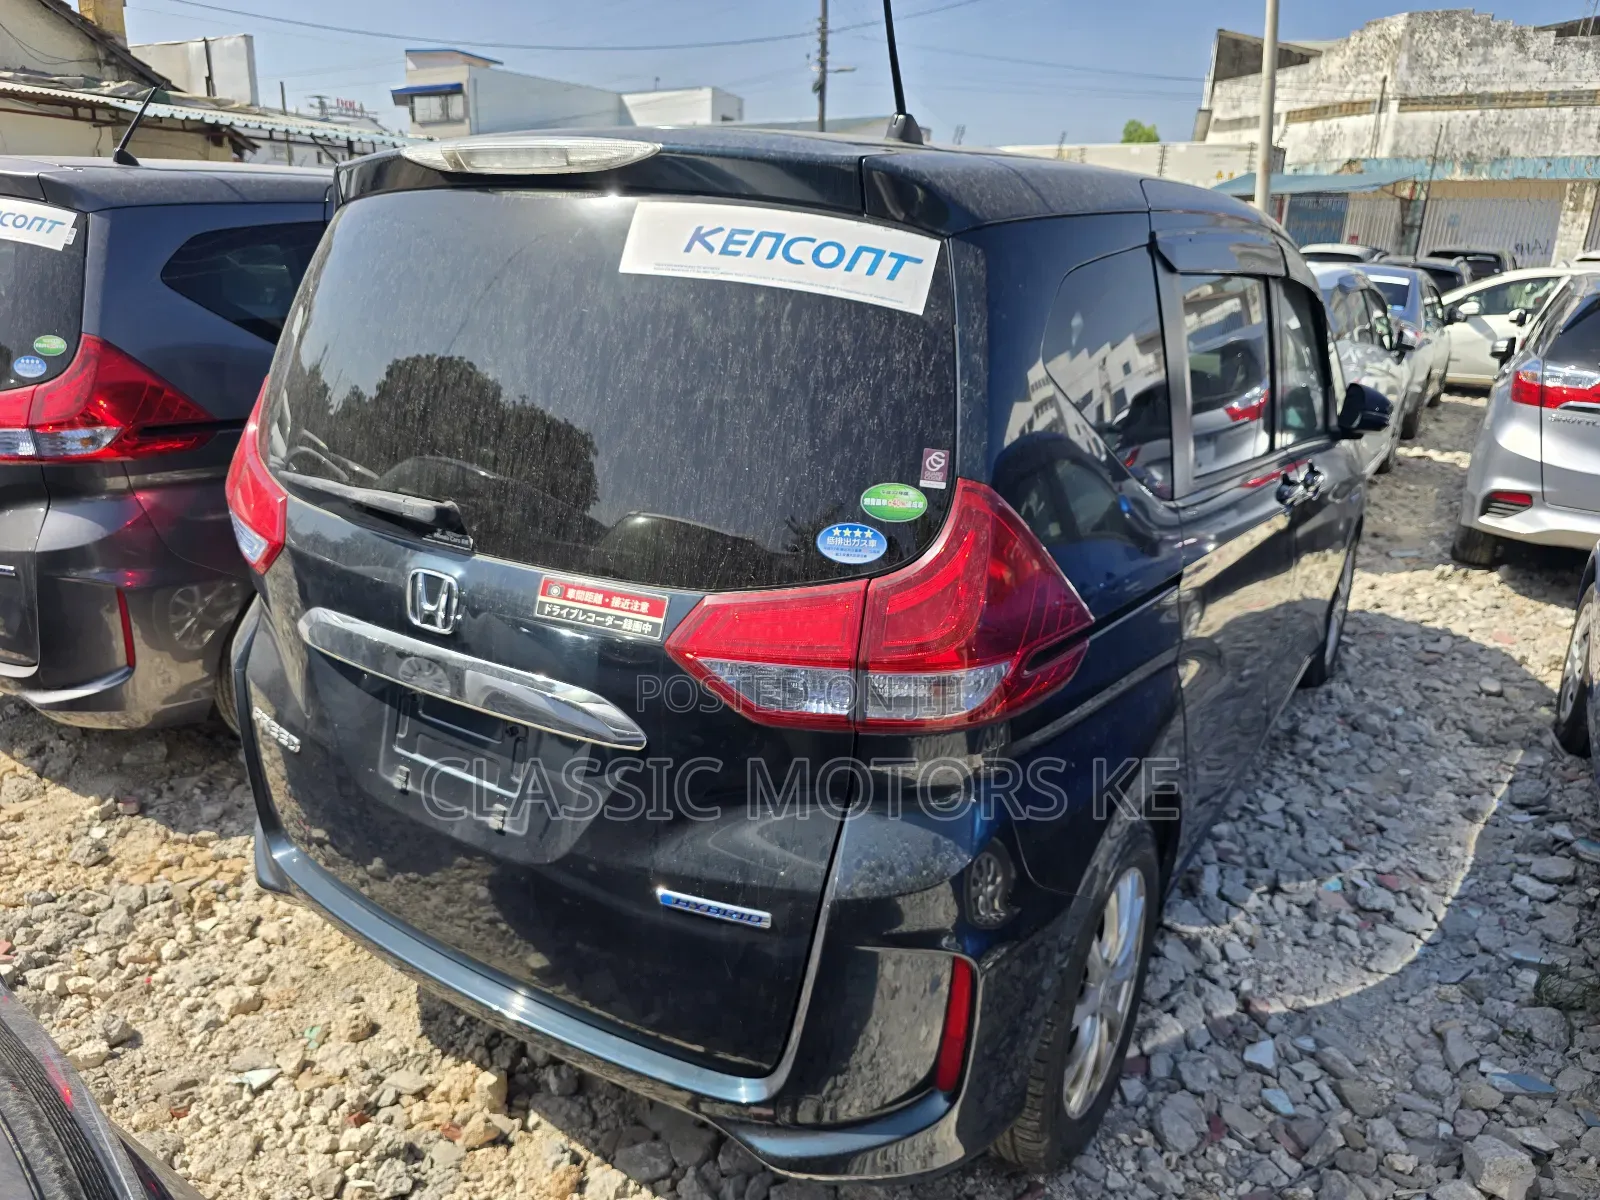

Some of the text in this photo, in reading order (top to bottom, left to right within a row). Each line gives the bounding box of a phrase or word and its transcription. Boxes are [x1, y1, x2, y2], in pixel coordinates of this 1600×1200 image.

[0, 210, 66, 234] CONT
[826, 535, 878, 548] 低排出ガス車
[543, 602, 653, 635] ドライブレコーダー録画中
